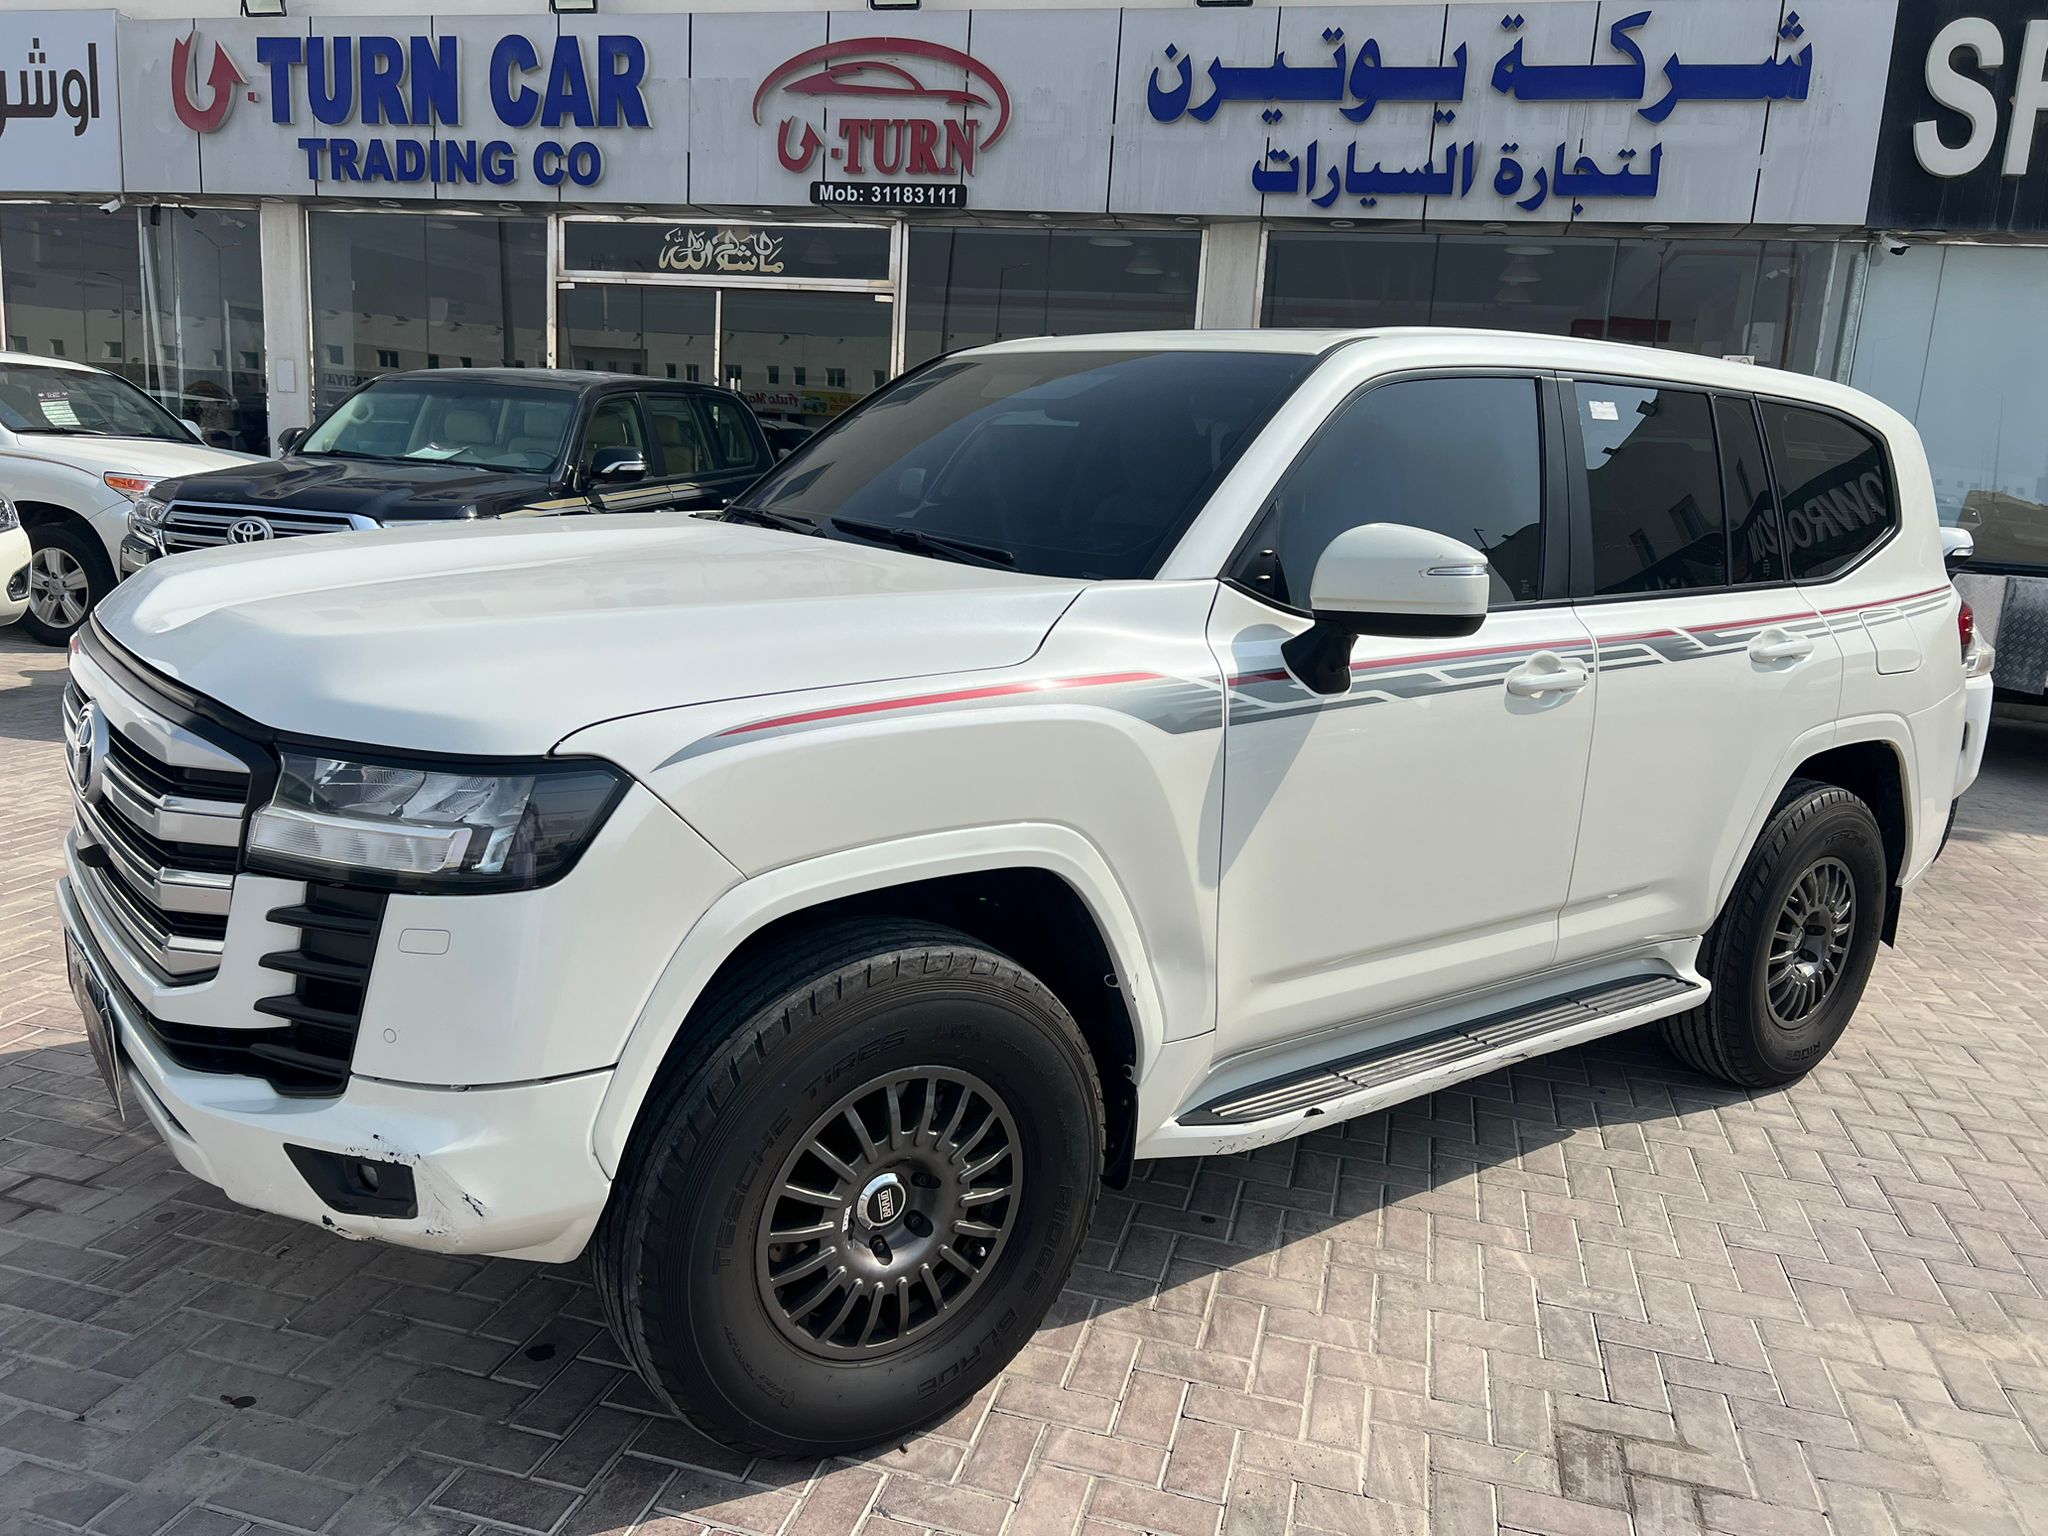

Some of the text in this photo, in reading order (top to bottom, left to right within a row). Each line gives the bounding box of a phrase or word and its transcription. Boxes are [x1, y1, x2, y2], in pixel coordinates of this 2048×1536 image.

[490, 34, 653, 129] CAR
[1147, 10, 1813, 124] شركة يوتيرن
[298, 137, 605, 186] TRADING CO
[818, 184, 957, 204] Mob: 31183111
[1252, 139, 1663, 215] لتجارة السيارات
